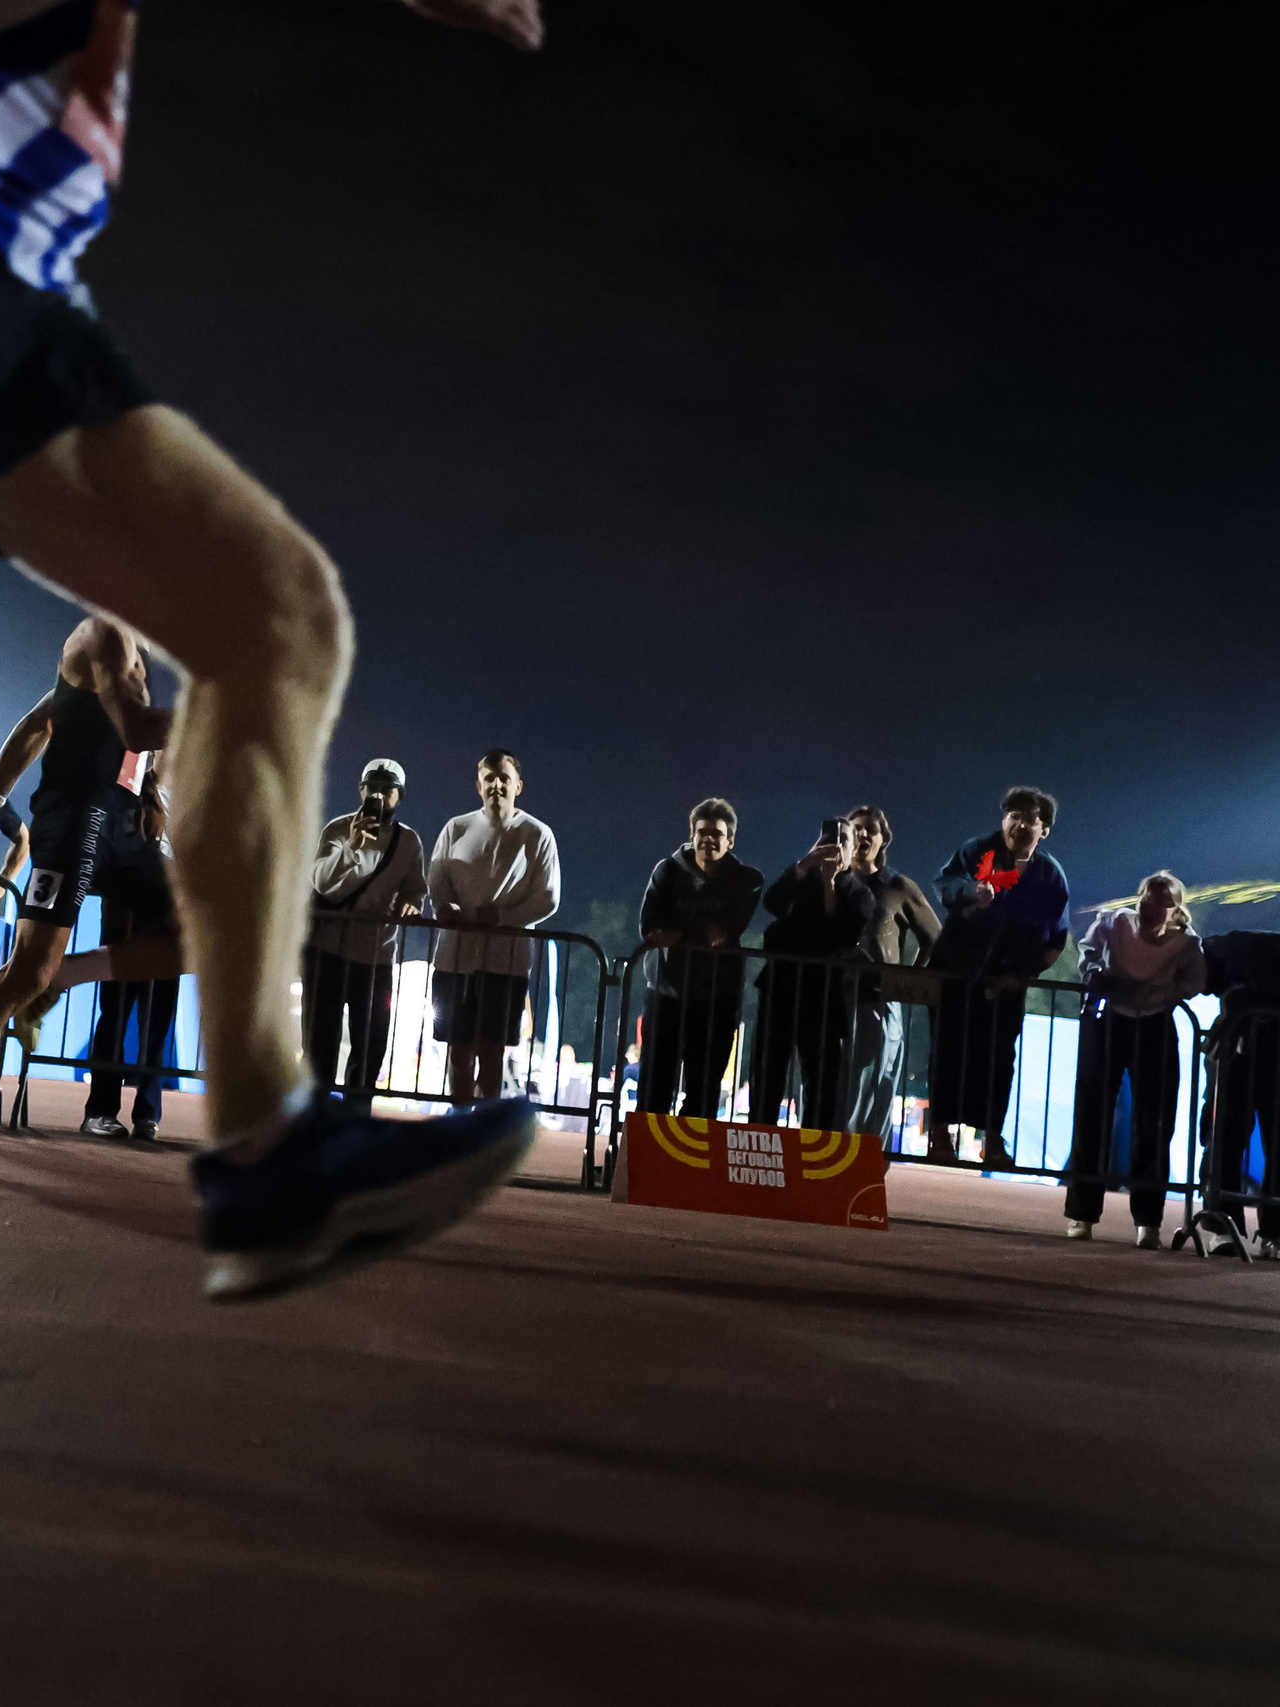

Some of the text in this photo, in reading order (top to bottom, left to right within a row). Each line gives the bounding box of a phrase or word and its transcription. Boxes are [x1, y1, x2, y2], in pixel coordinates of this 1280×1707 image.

[33, 873, 54, 903] 3
[726, 1128, 784, 1154] БИТВА
[727, 1150, 784, 1170] БЕГОВЫХ
[728, 1166, 787, 1188] КЛУБОВ
